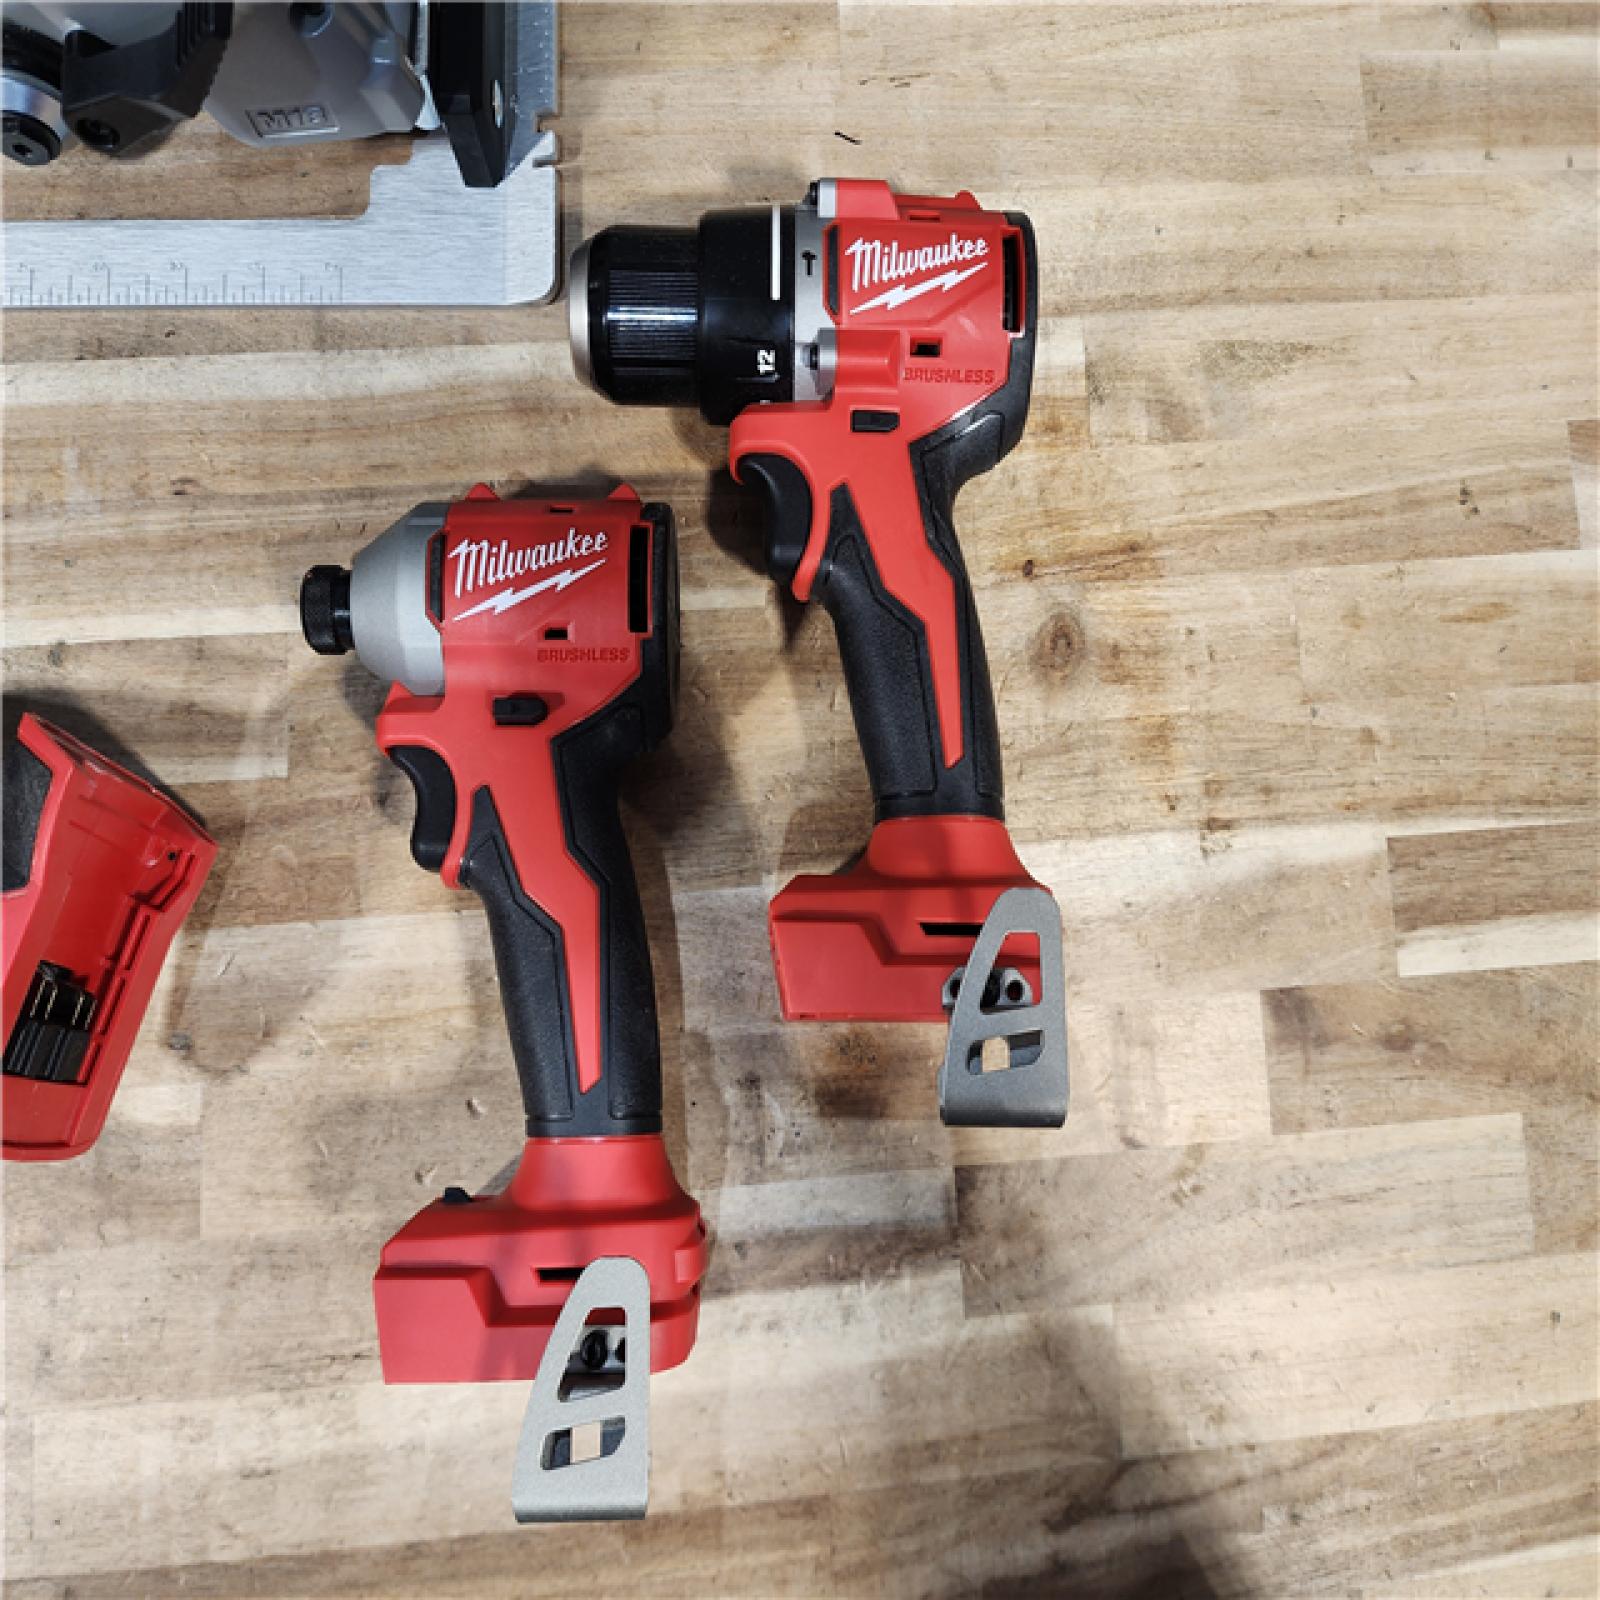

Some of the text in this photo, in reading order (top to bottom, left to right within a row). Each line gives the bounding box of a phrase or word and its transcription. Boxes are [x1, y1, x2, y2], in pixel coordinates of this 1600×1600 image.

[844, 232, 990, 293] Milwaukee
[756, 349, 776, 375] 12
[902, 367, 996, 384] BRUSHLESS
[447, 527, 609, 599] Milwaukee
[536, 647, 630, 664] BRUSHLESS
